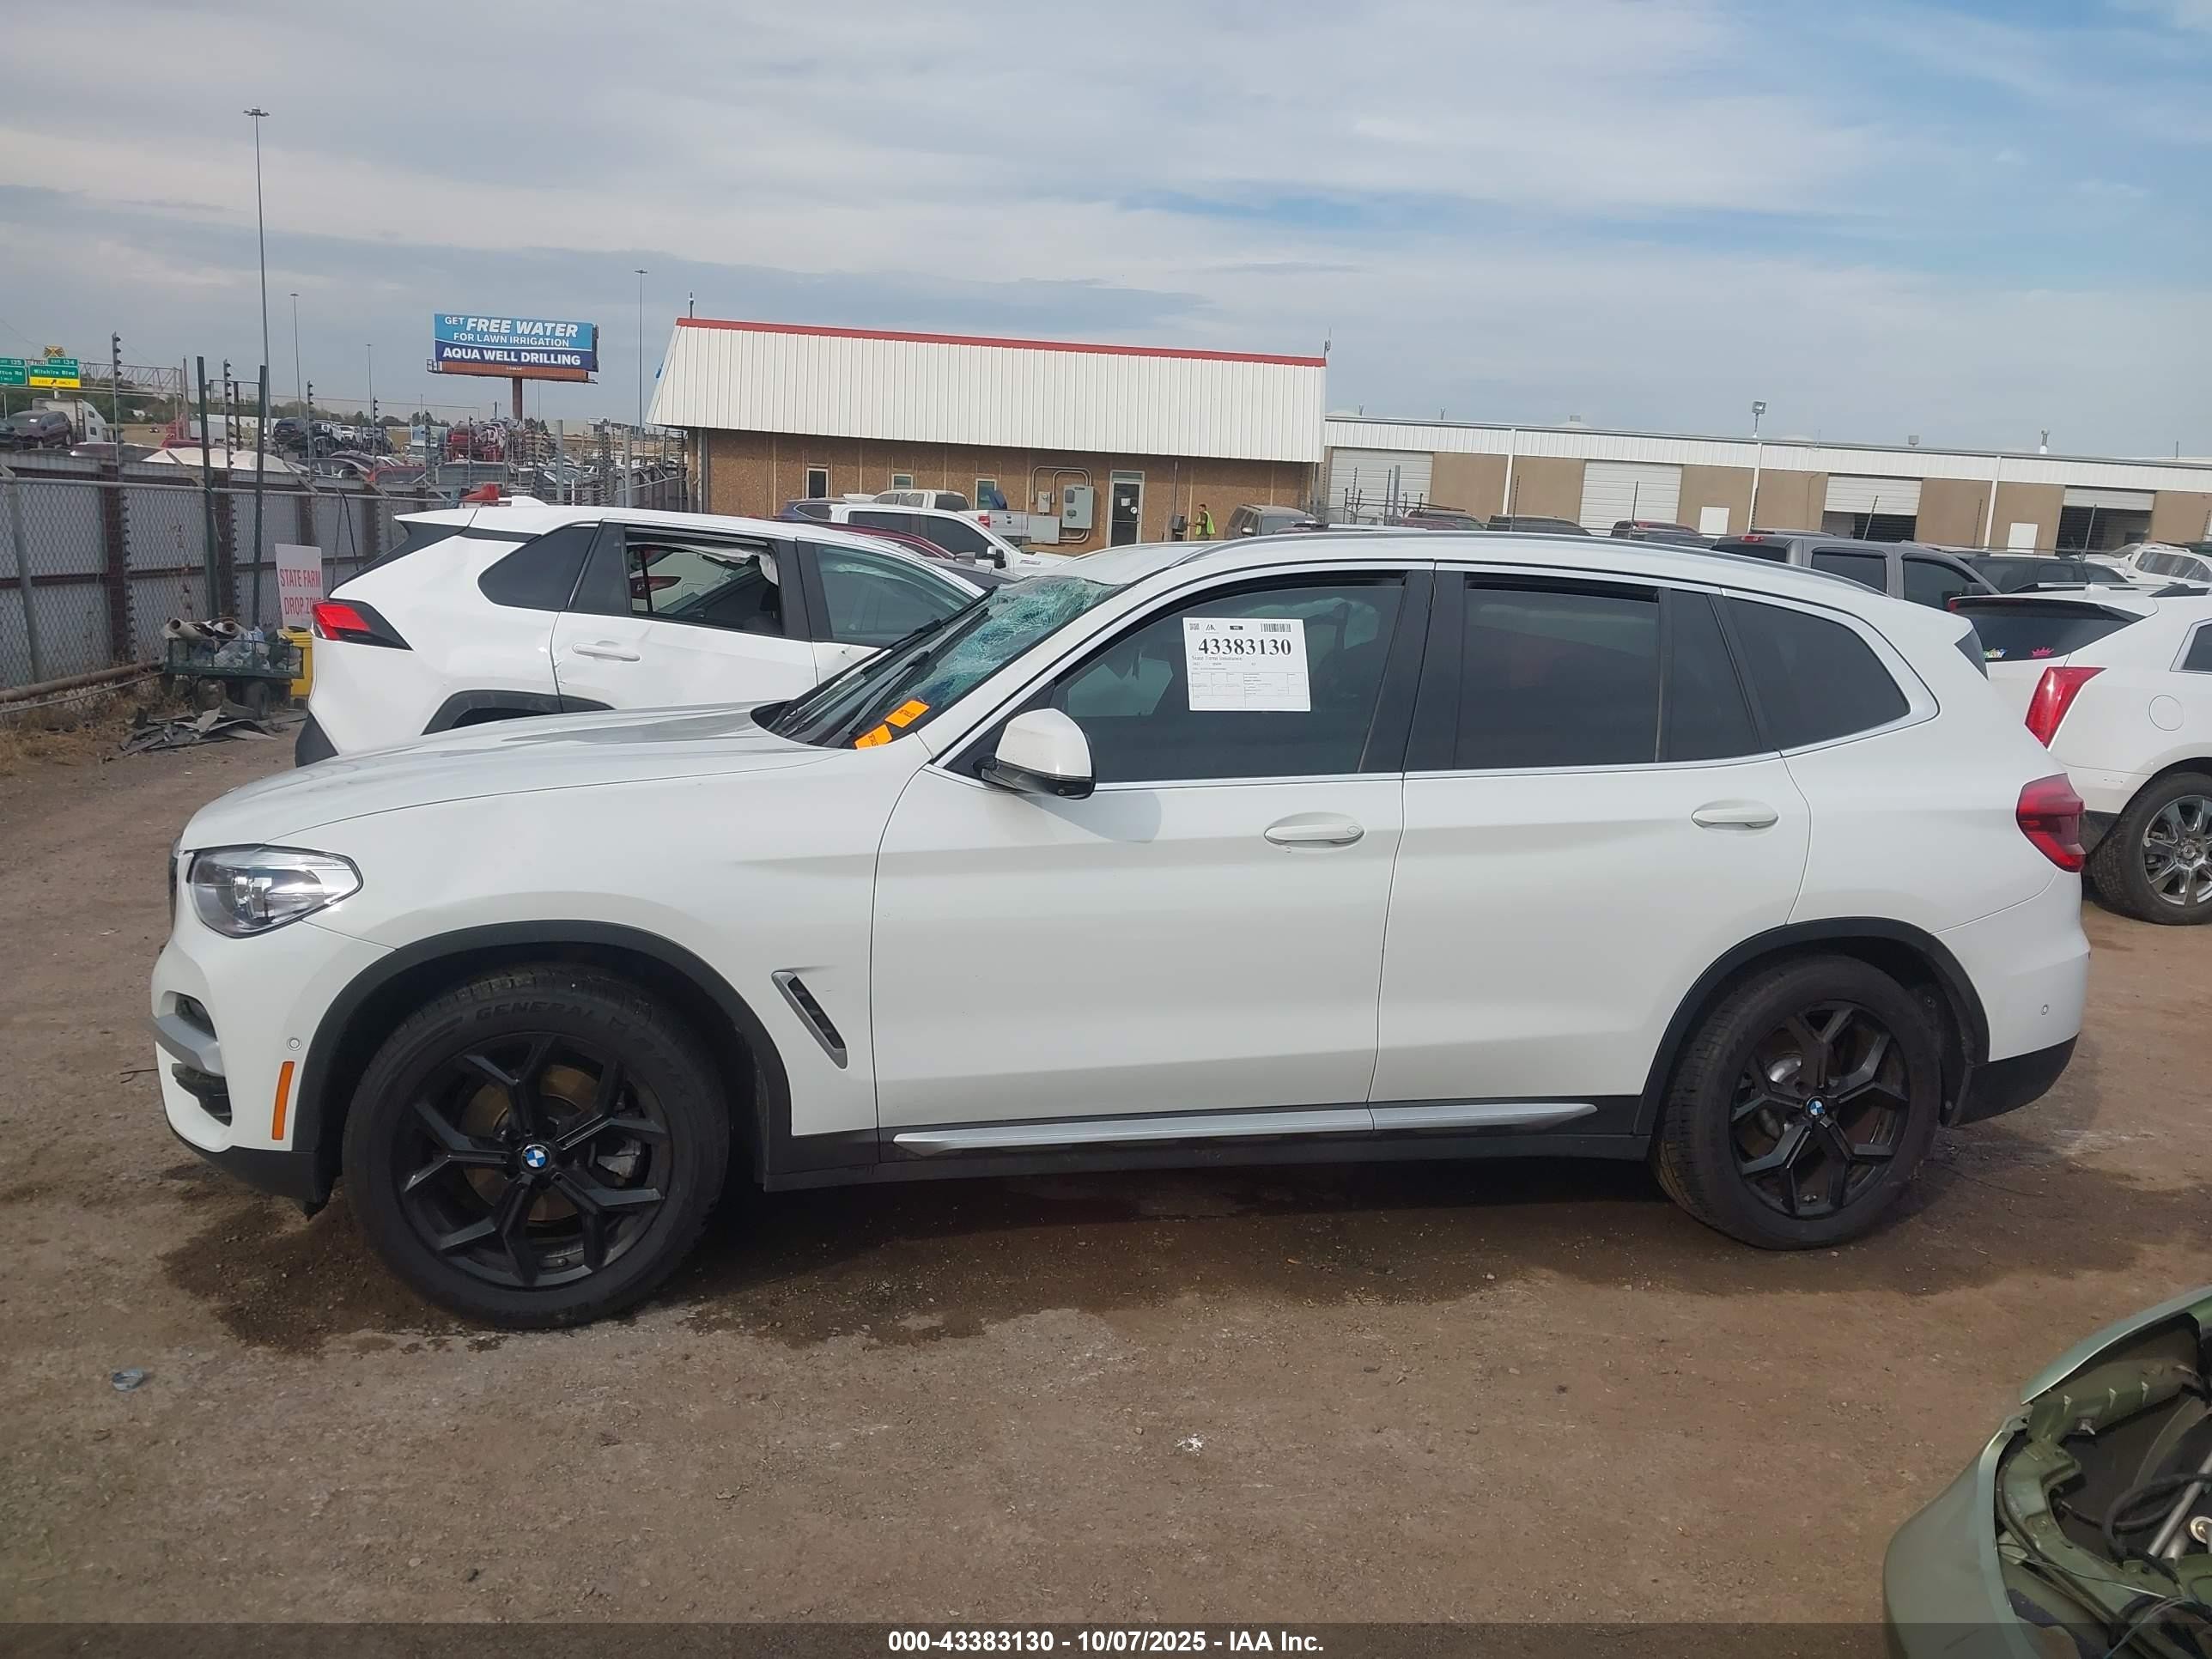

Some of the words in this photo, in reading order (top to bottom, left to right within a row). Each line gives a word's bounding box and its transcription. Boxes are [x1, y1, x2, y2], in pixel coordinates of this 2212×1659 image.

[445, 316, 465, 325] GET
[465, 318, 512, 333] FREE
[516, 320, 579, 337] WATER
[453, 332, 475, 342] FOR
[477, 334, 507, 343] LAWN
[509, 336, 569, 347] IRRIGATION
[442, 347, 480, 360] AQUA
[483, 349, 518, 362] WELL
[520, 352, 580, 366] DRILLING
[280, 569, 302, 587] STATE
[303, 570, 321, 588] FARM
[284, 597, 303, 615] DROP
[1198, 638, 1291, 655] 43383130
[476, 1001, 595, 1022] GENERAL
